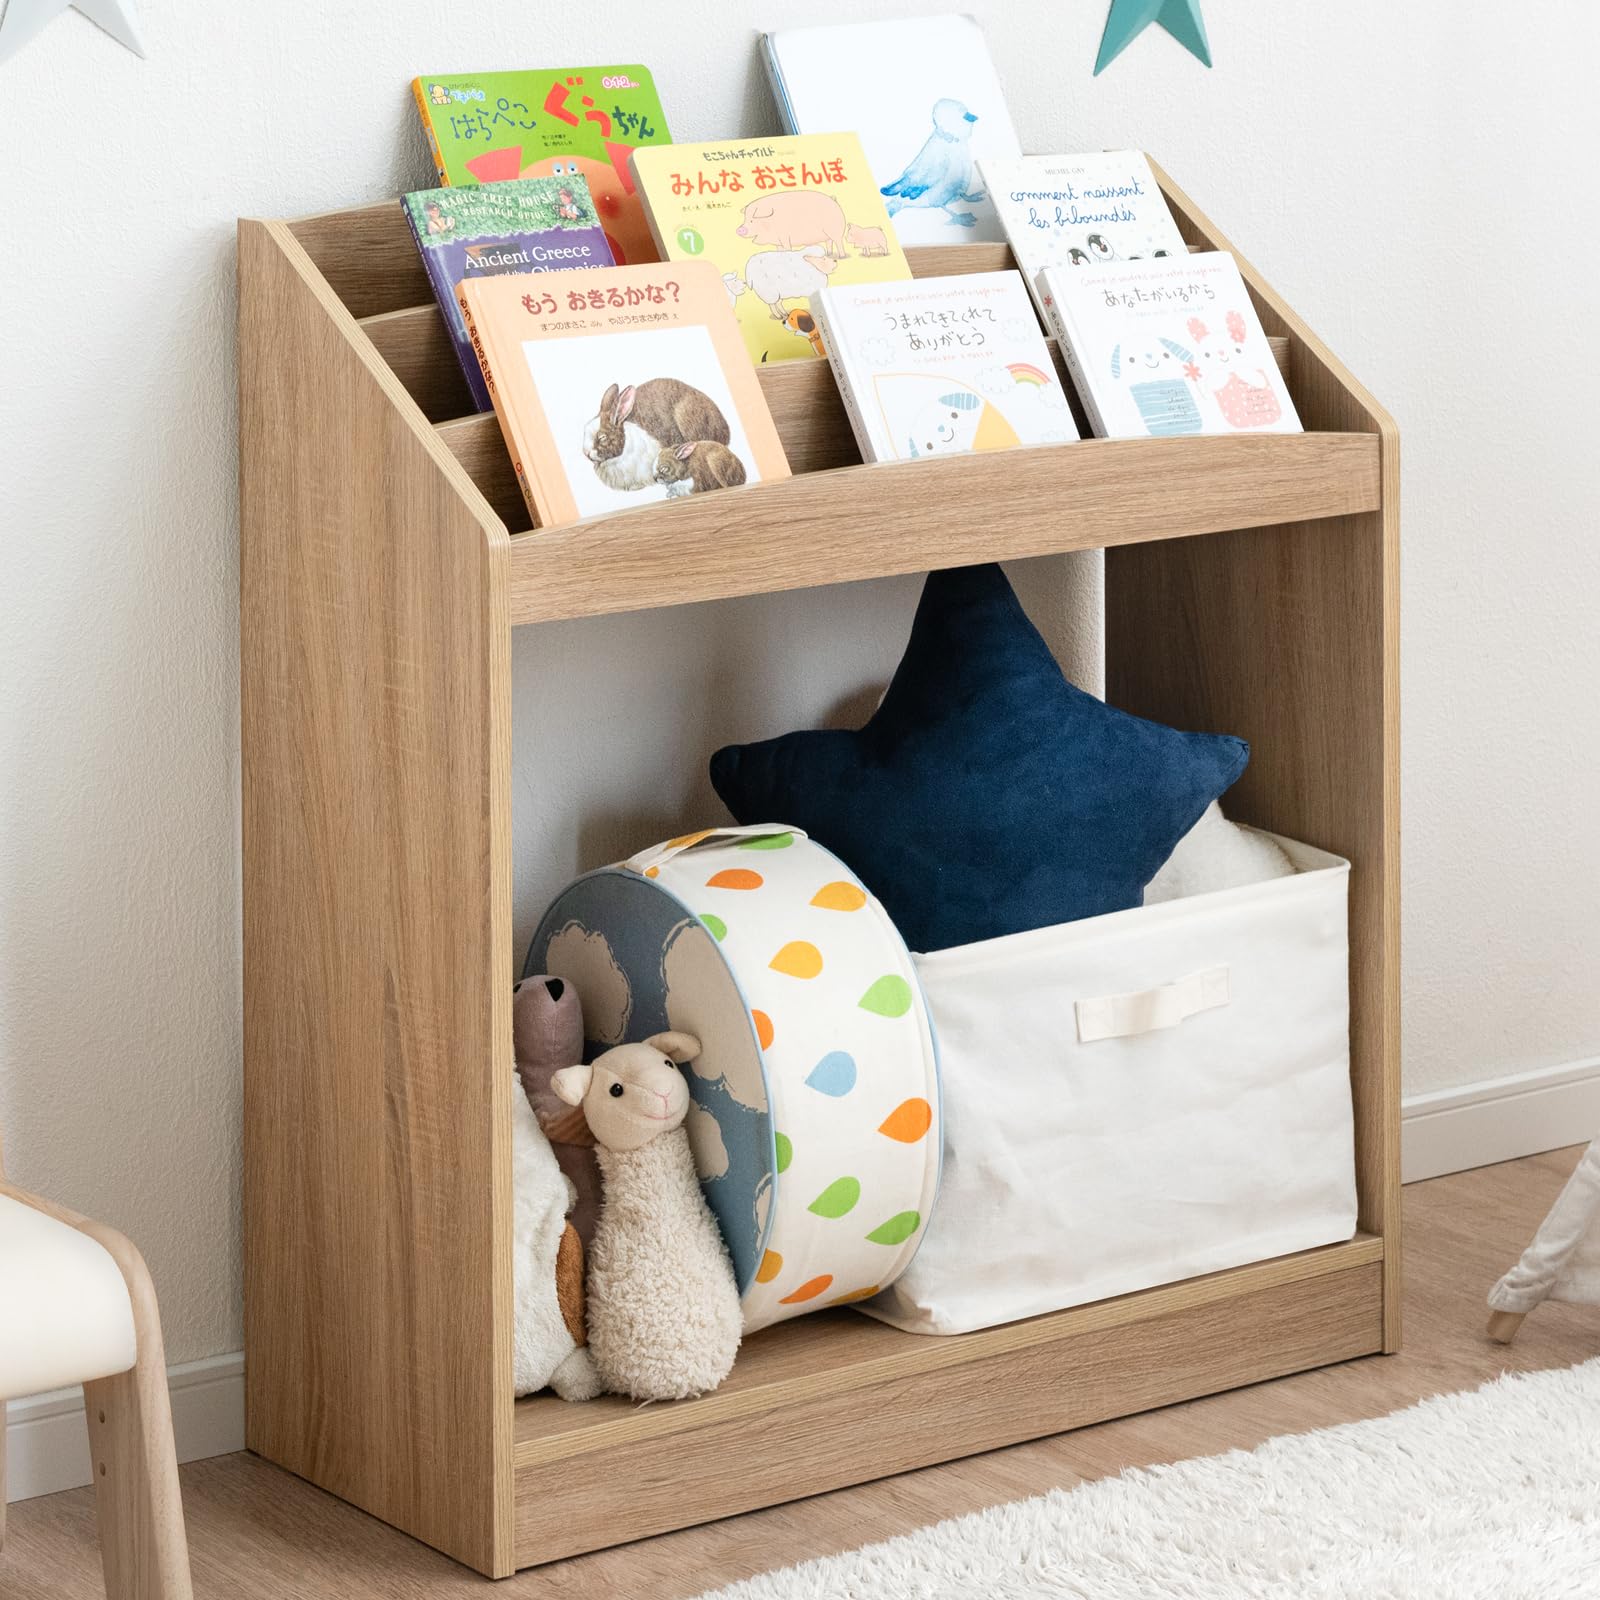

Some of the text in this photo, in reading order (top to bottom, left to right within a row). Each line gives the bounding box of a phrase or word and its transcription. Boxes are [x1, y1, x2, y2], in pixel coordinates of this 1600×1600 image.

[450, 98, 536, 141] はらぺこ
[670, 157, 848, 196] みんな おさんぽ
[1010, 176, 1145, 201] comment naissent
[440, 191, 555, 209] MAGIC TREE HOUSE
[462, 207, 546, 220] RESEARCH GUIDE
[1028, 207, 1050, 228] les
[682, 231, 696, 253] 7
[465, 245, 592, 270] Ancient Greece
[521, 281, 680, 315] もう おきるかな?
[1101, 283, 1216, 308] あなたがいるから
[540, 319, 587, 331] まつのまさこ
[883, 305, 998, 331] うまれてきてくれて
[906, 326, 985, 351] ありがとう
